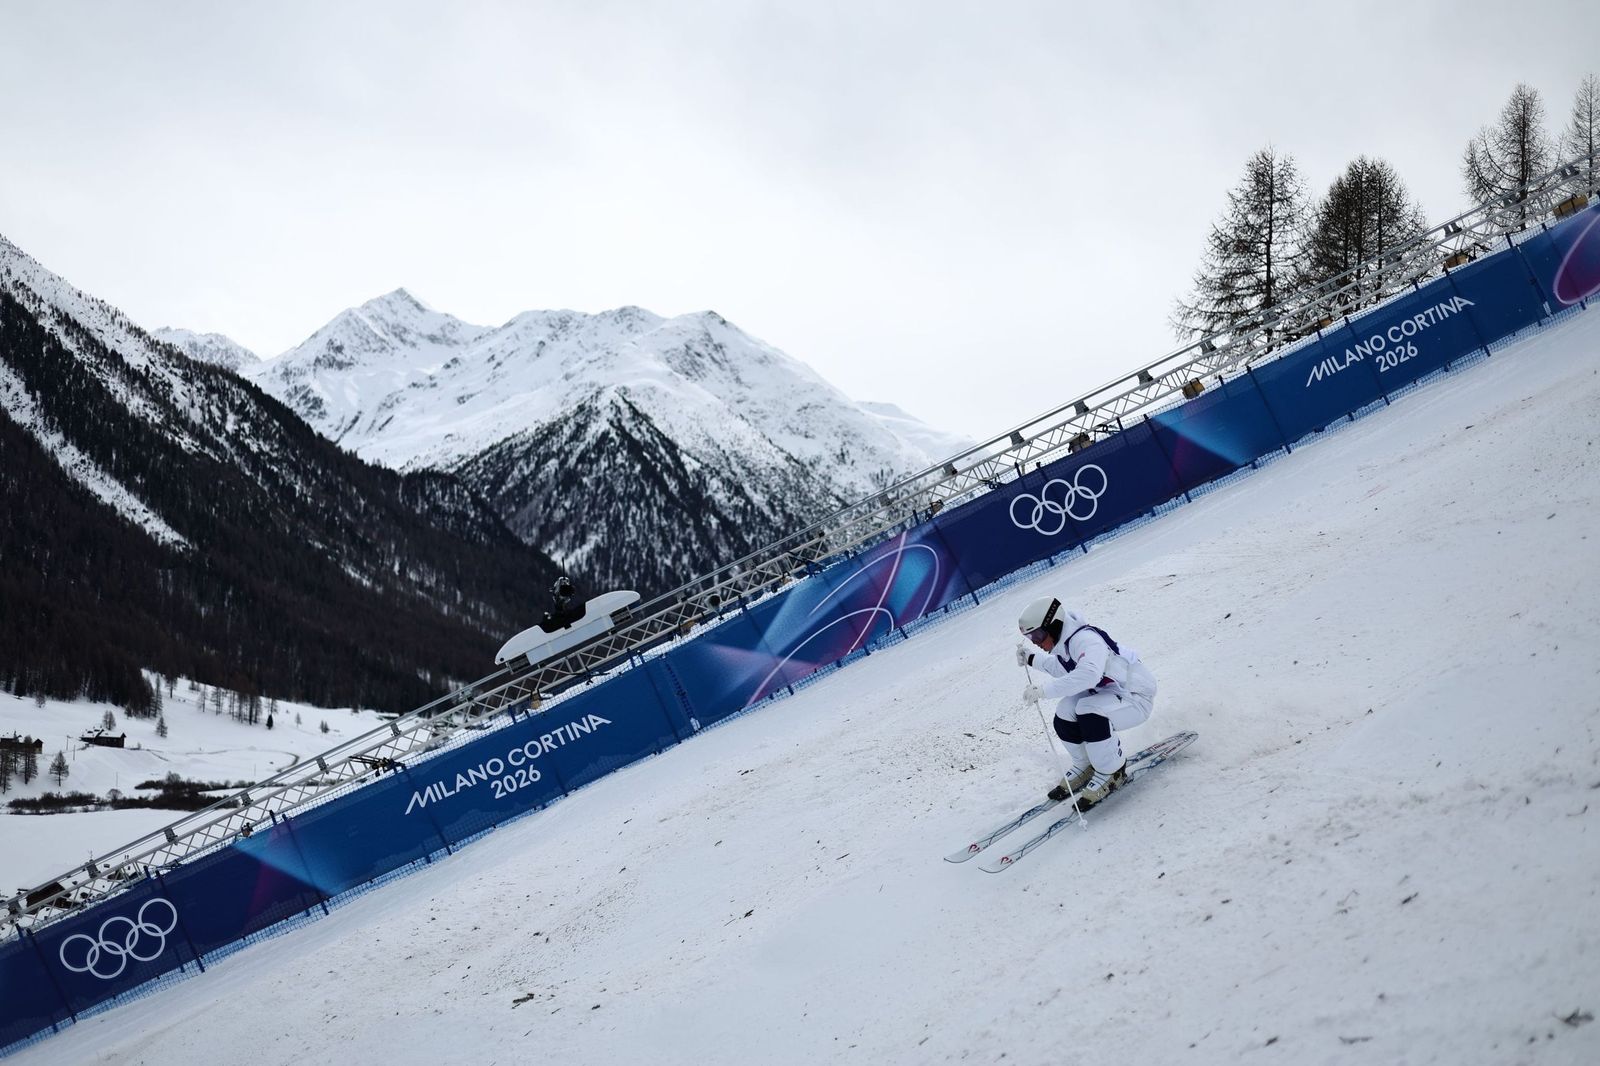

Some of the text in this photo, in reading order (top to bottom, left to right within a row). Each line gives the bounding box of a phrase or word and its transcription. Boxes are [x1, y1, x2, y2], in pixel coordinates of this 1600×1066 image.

[1306, 296, 1475, 387] MILANO CORTINA
[1375, 342, 1418, 372] 2026
[404, 713, 612, 815] MILANO CORTINA
[490, 765, 541, 799] 2026
